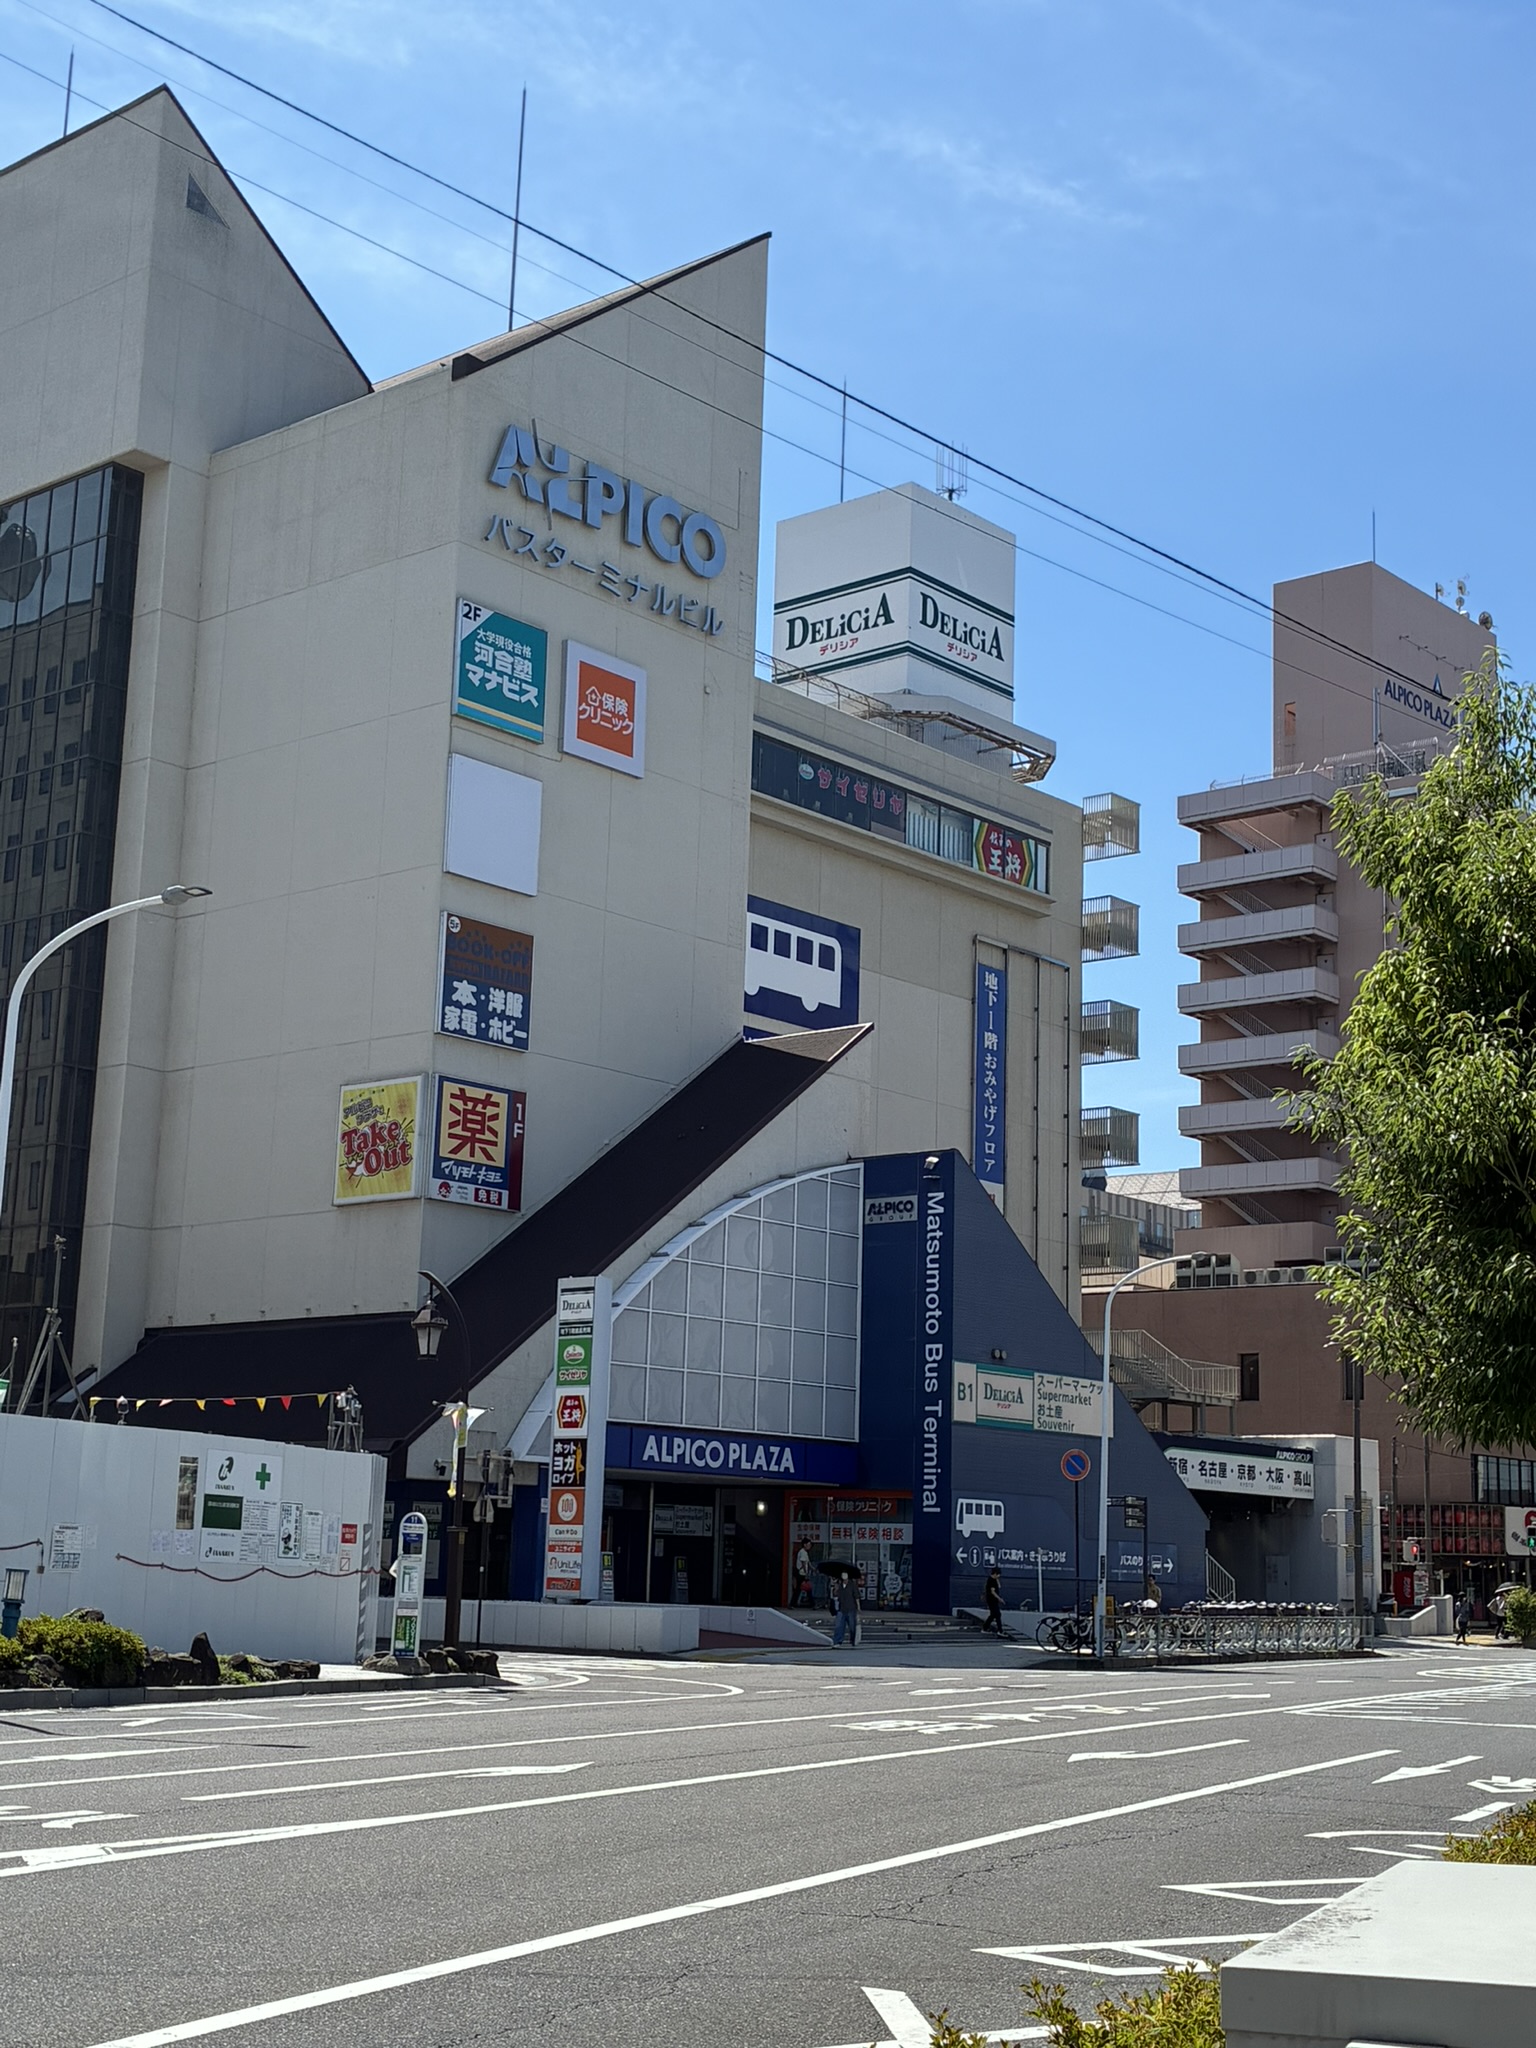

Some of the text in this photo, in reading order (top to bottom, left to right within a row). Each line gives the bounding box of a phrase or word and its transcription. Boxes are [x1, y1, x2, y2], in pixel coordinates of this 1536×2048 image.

[488, 421, 727, 580] ALPICO
[484, 514, 724, 637] バスターミナルビル
[461, 602, 482, 623] 2F
[476, 627, 532, 659] 大学現役合格
[819, 636, 859, 656] デリシア
[946, 641, 978, 662] デリシア
[473, 642, 533, 682] 河合塾
[465, 663, 540, 708] マナビス
[1384, 679, 1423, 713] ALPICO
[602, 691, 629, 717] 保険
[578, 703, 634, 736] クリニック
[817, 767, 904, 816] サイゼリヤ
[988, 846, 1022, 880] 王将
[451, 980, 524, 1019] 本・洋服
[444, 1005, 528, 1045] 家電・ホビー
[447, 1087, 500, 1163] 薬
[341, 1119, 401, 1158] Take
[363, 1141, 414, 1177] Out
[441, 1160, 503, 1185] マツモトキヨシ
[867, 1199, 914, 1216] ALPICO
[868, 1214, 913, 1222] GROUP
[922, 1191, 945, 1513] Matsumoto Bus Terminal
[957, 1381, 973, 1403] B1
[1037, 1374, 1105, 1396] スーパーマーケッ
[1037, 1388, 1092, 1407] Supermarket
[561, 1409, 582, 1424] 王将
[1036, 1403, 1063, 1420] お土産
[1036, 1418, 1075, 1432] Souvenir
[554, 1441, 577, 1454] ホット
[642, 1435, 795, 1474] ALPICO PLAZA
[552, 1456, 576, 1472] ヨガ
[552, 1472, 575, 1484] ロイブ
[558, 1557, 581, 1569] UniLife
